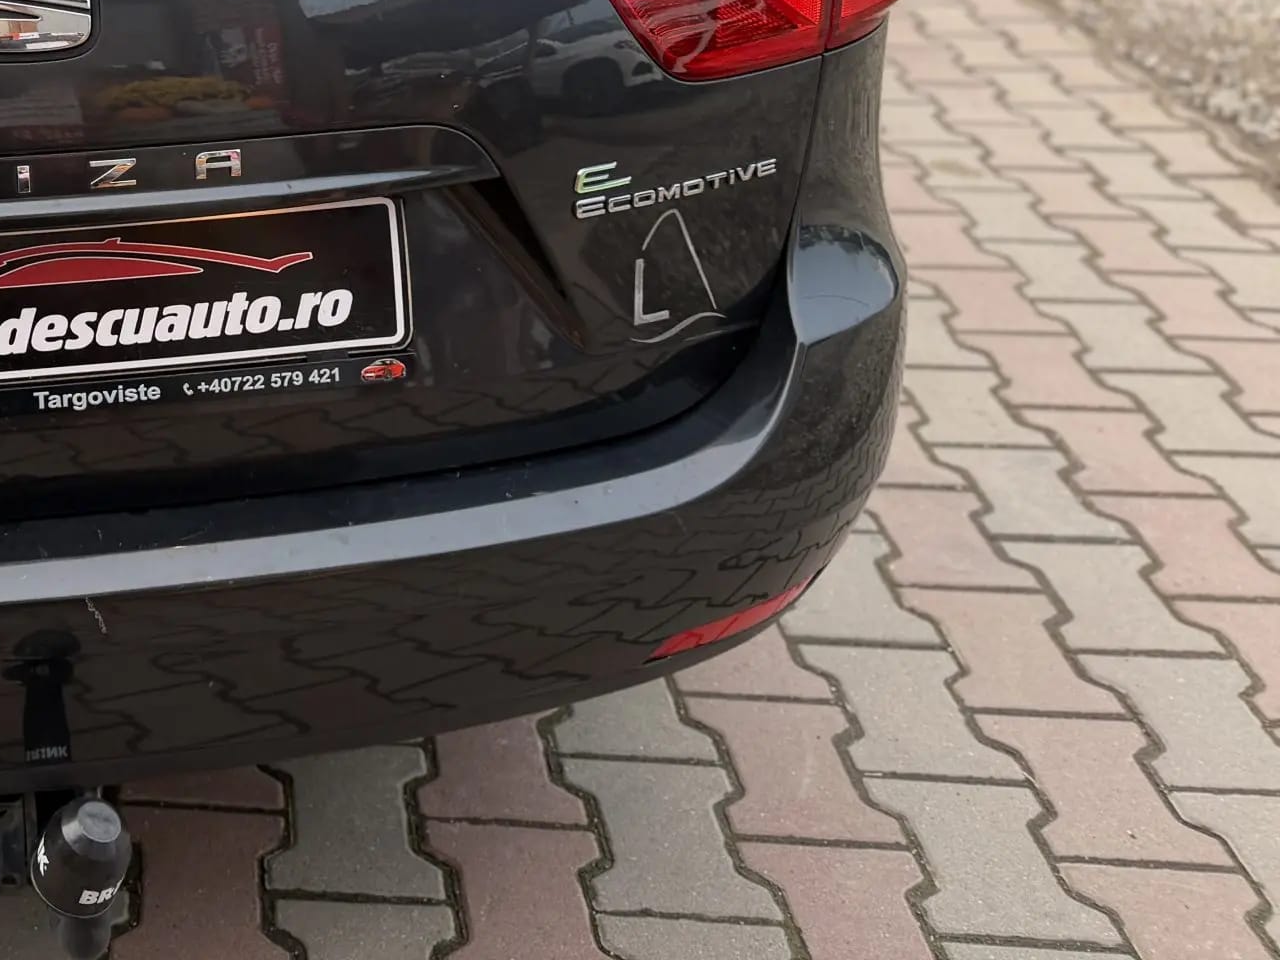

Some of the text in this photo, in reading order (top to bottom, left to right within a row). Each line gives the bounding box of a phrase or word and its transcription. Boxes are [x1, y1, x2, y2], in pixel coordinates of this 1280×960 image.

[33, 383, 161, 411] Targoviste
[196, 375, 265, 394] +40722
[270, 371, 304, 388] 579
[308, 367, 341, 384] 421
